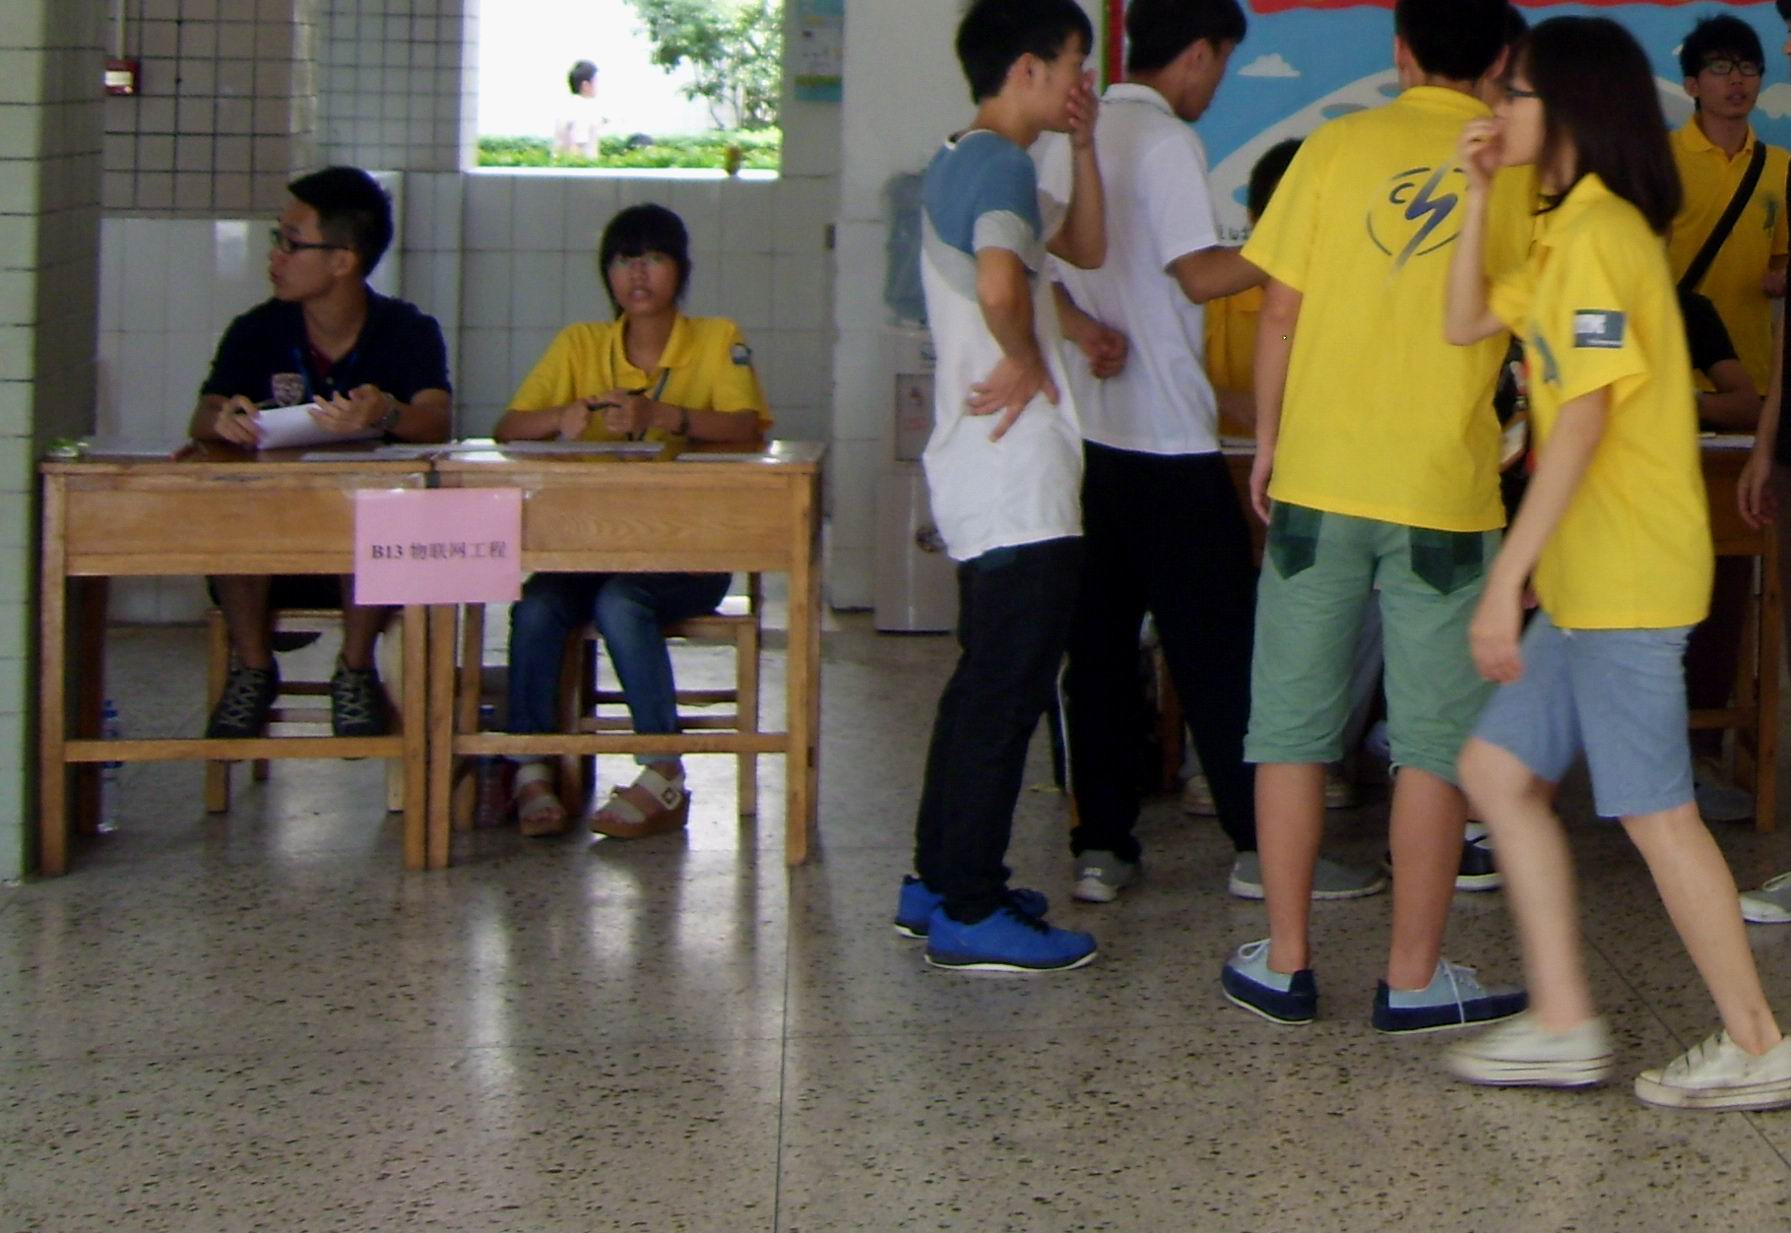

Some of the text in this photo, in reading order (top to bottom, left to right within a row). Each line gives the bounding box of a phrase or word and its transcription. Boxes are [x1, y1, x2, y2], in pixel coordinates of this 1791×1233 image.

[371, 541, 507, 560] B13 物联网工程
